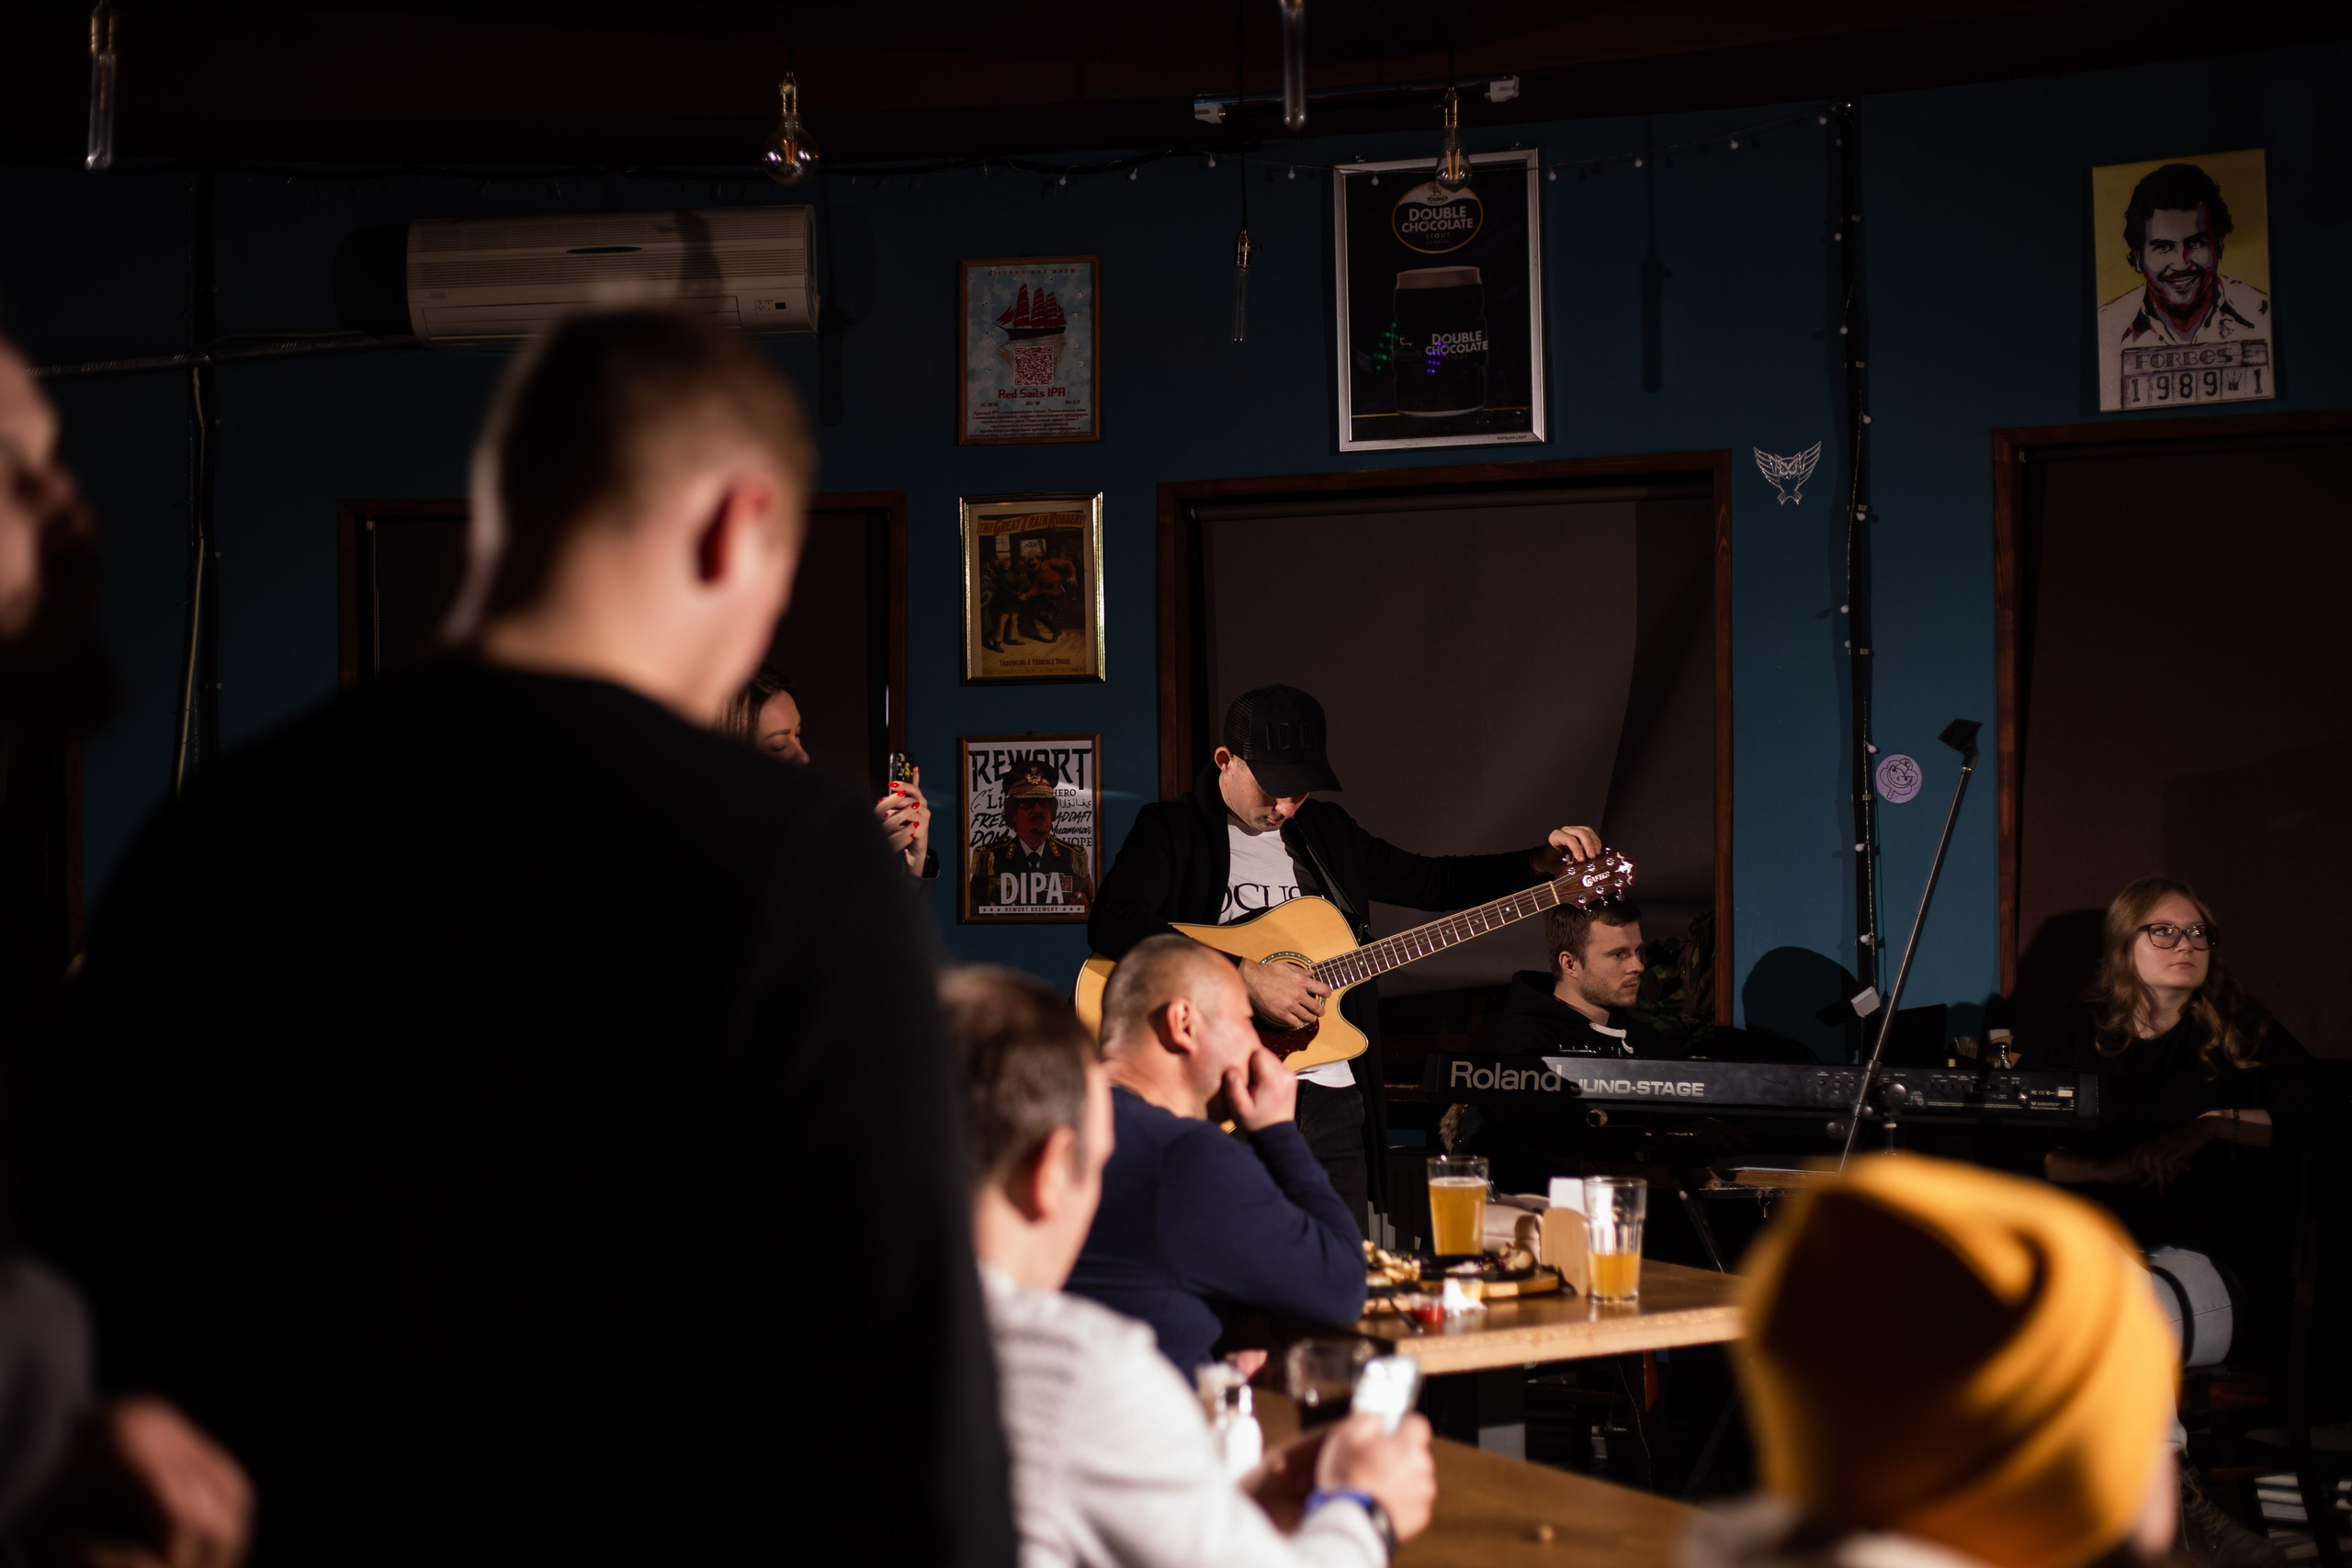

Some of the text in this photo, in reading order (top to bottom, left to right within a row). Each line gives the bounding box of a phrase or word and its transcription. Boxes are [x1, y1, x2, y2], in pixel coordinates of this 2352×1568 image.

[1408, 206, 1466, 221] DOUBLE
[1401, 218, 1474, 233] CHOCOLATE
[1431, 331, 1482, 345] DOUBLE
[1425, 340, 1488, 355] CHOCOLATE
[998, 387, 1066, 399] Red Sails IPA
[978, 512, 1087, 536] THE GREAT TRAIN ROBBERY
[968, 749, 1092, 792] REWORT
[1053, 811, 1092, 824] ADDAFI
[1581, 871, 1611, 887] CRAFTER
[1001, 872, 1065, 905] DIPA
[1450, 1060, 1562, 1092] Roland
[1569, 1078, 1705, 1097] JUNO-STAGE
